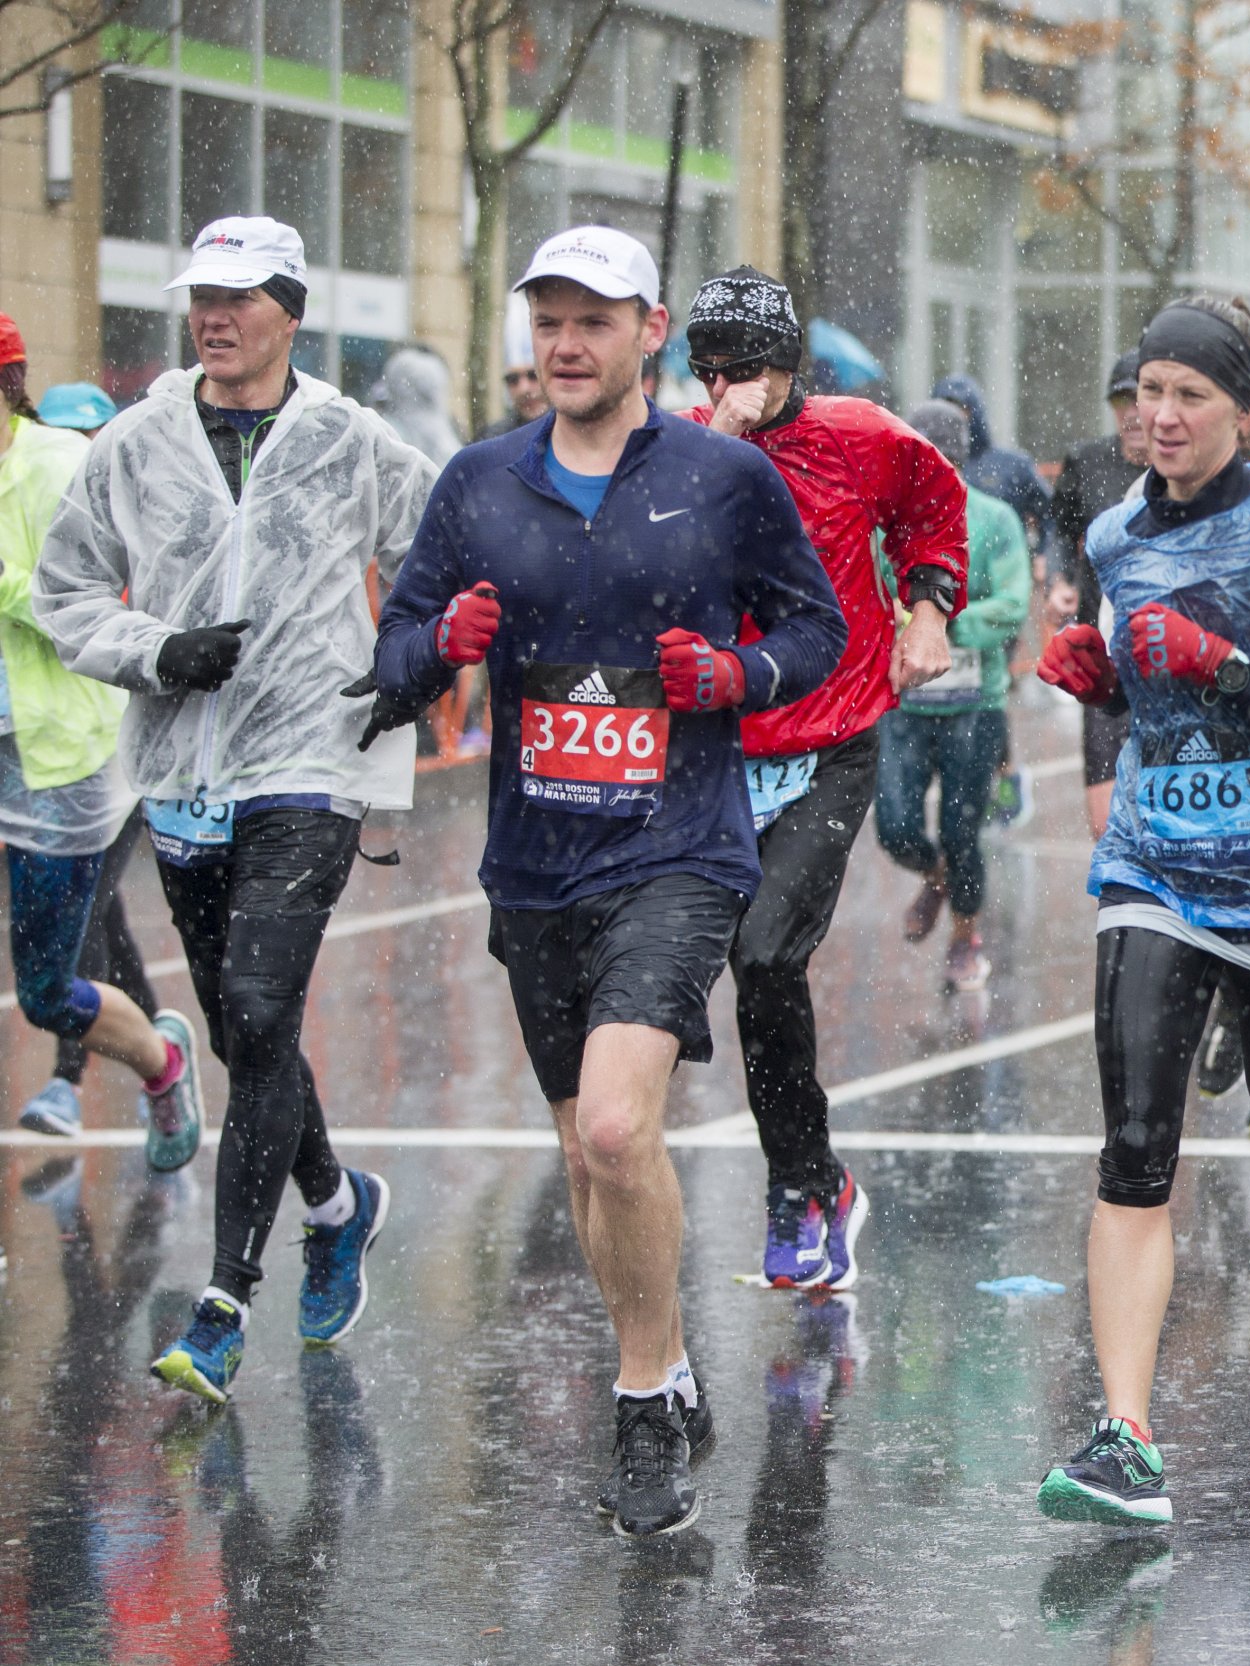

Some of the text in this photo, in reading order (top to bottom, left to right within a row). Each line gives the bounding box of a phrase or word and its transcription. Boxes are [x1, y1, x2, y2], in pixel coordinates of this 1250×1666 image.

[197, 233, 244, 249] NMAN
[568, 690, 616, 705] adidas
[533, 707, 655, 759] 3266
[522, 749, 533, 769] 4
[1176, 750, 1219, 762] adidas
[545, 781, 600, 795] 2018 BOSTON
[544, 789, 600, 804] MARATHON
[1181, 841, 1214, 851] BOSTON
